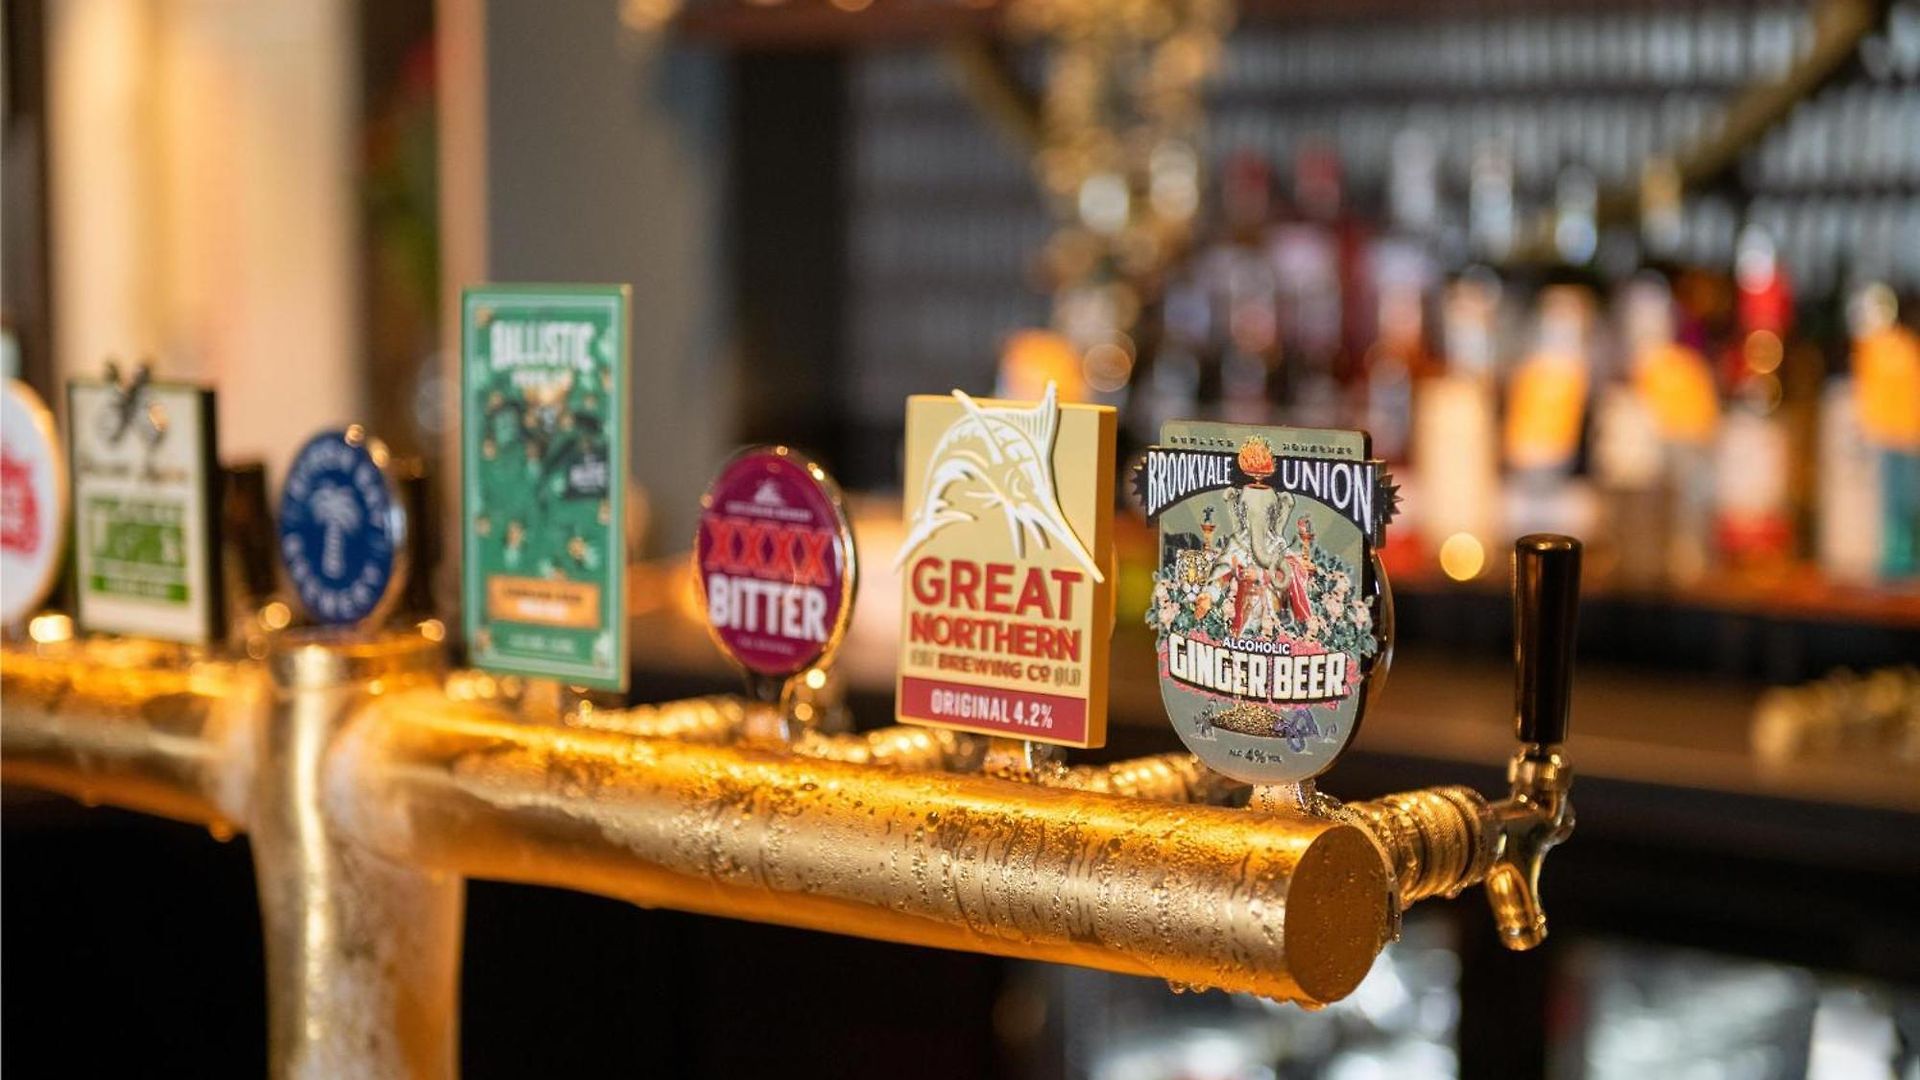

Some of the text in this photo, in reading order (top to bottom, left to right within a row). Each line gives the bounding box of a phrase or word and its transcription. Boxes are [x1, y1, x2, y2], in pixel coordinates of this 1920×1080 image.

[1147, 451, 1373, 534] BROOKVALE UNION
[704, 513, 834, 587] XXXX
[708, 573, 828, 643] BITTER
[911, 556, 1084, 621] GREAT
[909, 611, 1082, 663] NORTHERN
[938, 653, 1023, 679] BREWING
[1222, 637, 1290, 655] ALCOHOLIC
[1167, 632, 1347, 701] GINGER BEER
[930, 688, 1053, 729] ORIGINAL 4.2%
[1245, 747, 1266, 764] 4%
